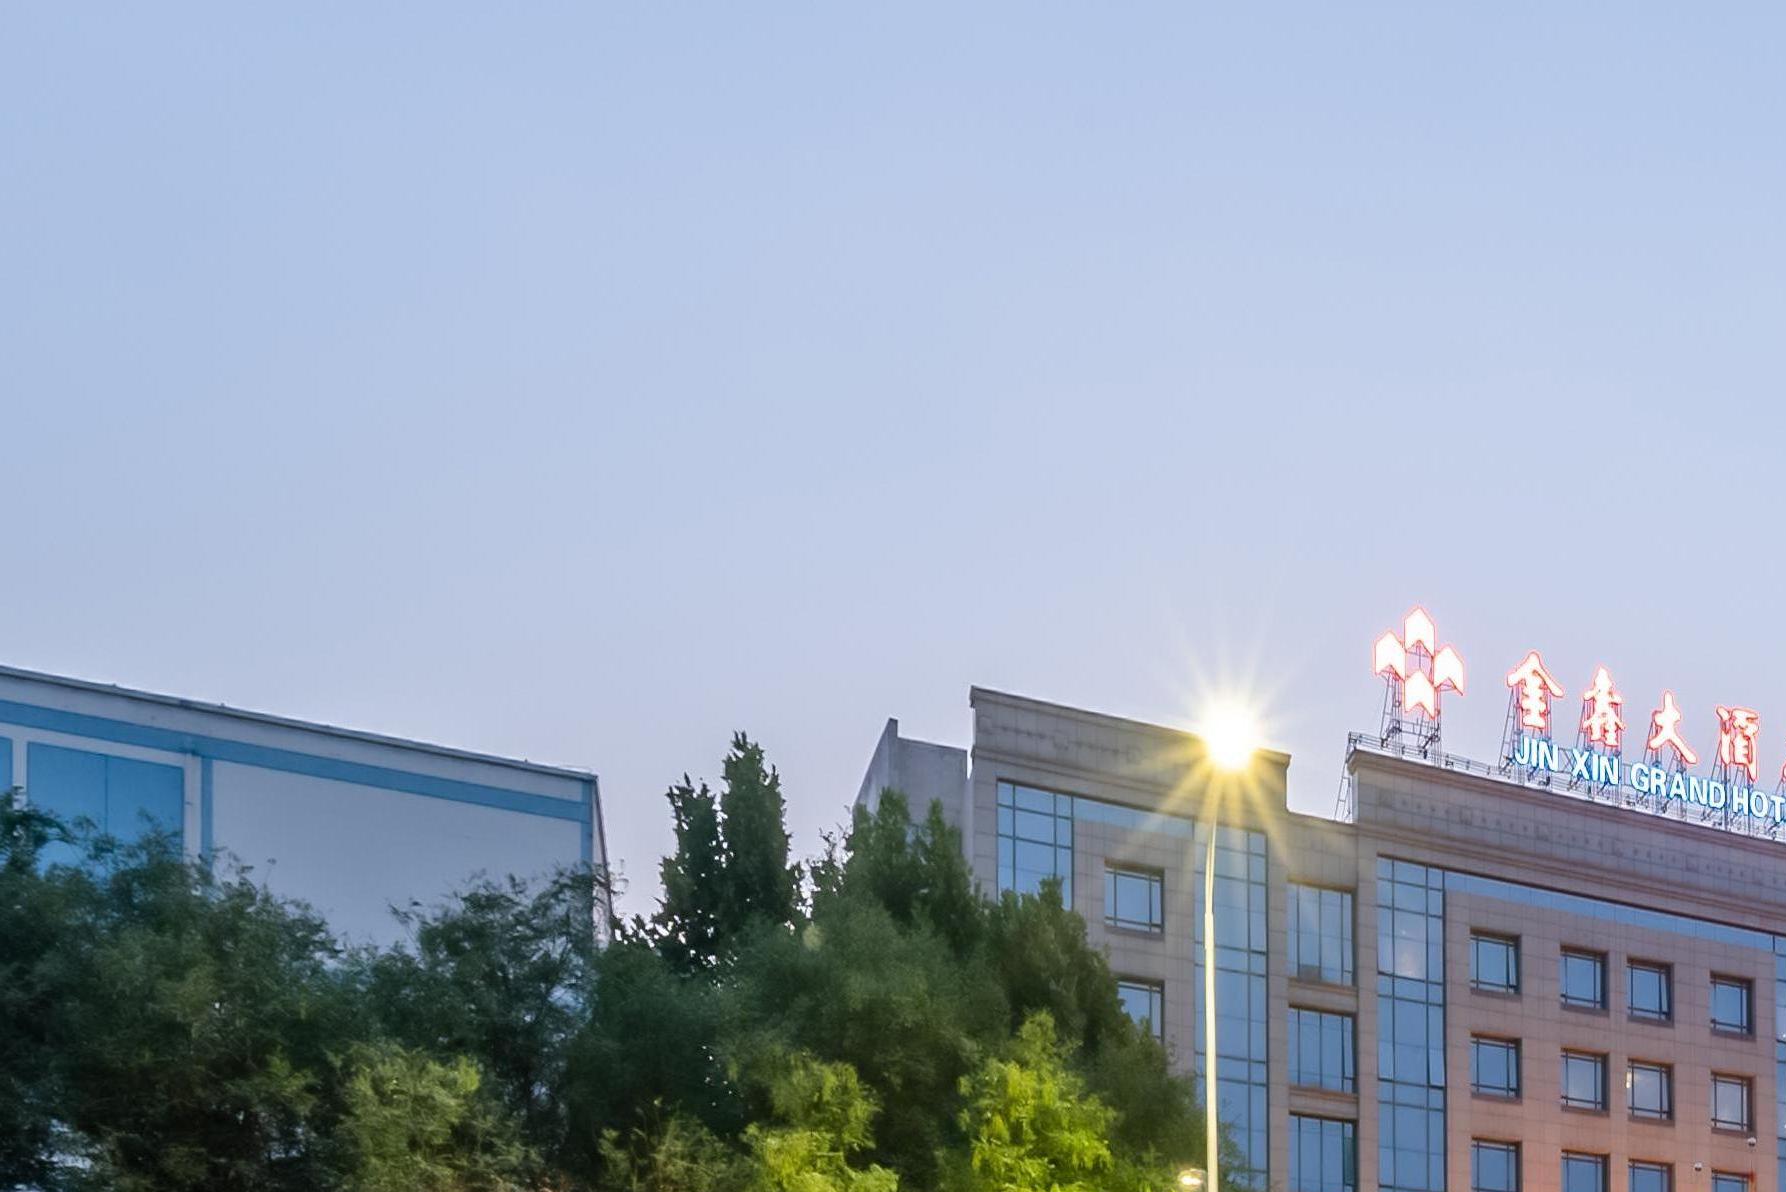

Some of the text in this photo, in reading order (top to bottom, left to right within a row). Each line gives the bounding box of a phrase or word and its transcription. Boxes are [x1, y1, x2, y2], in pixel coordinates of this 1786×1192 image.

[1514, 737, 1560, 773] JIN
[1571, 748, 1620, 785] XIN
[1630, 761, 1727, 811] GRAND
